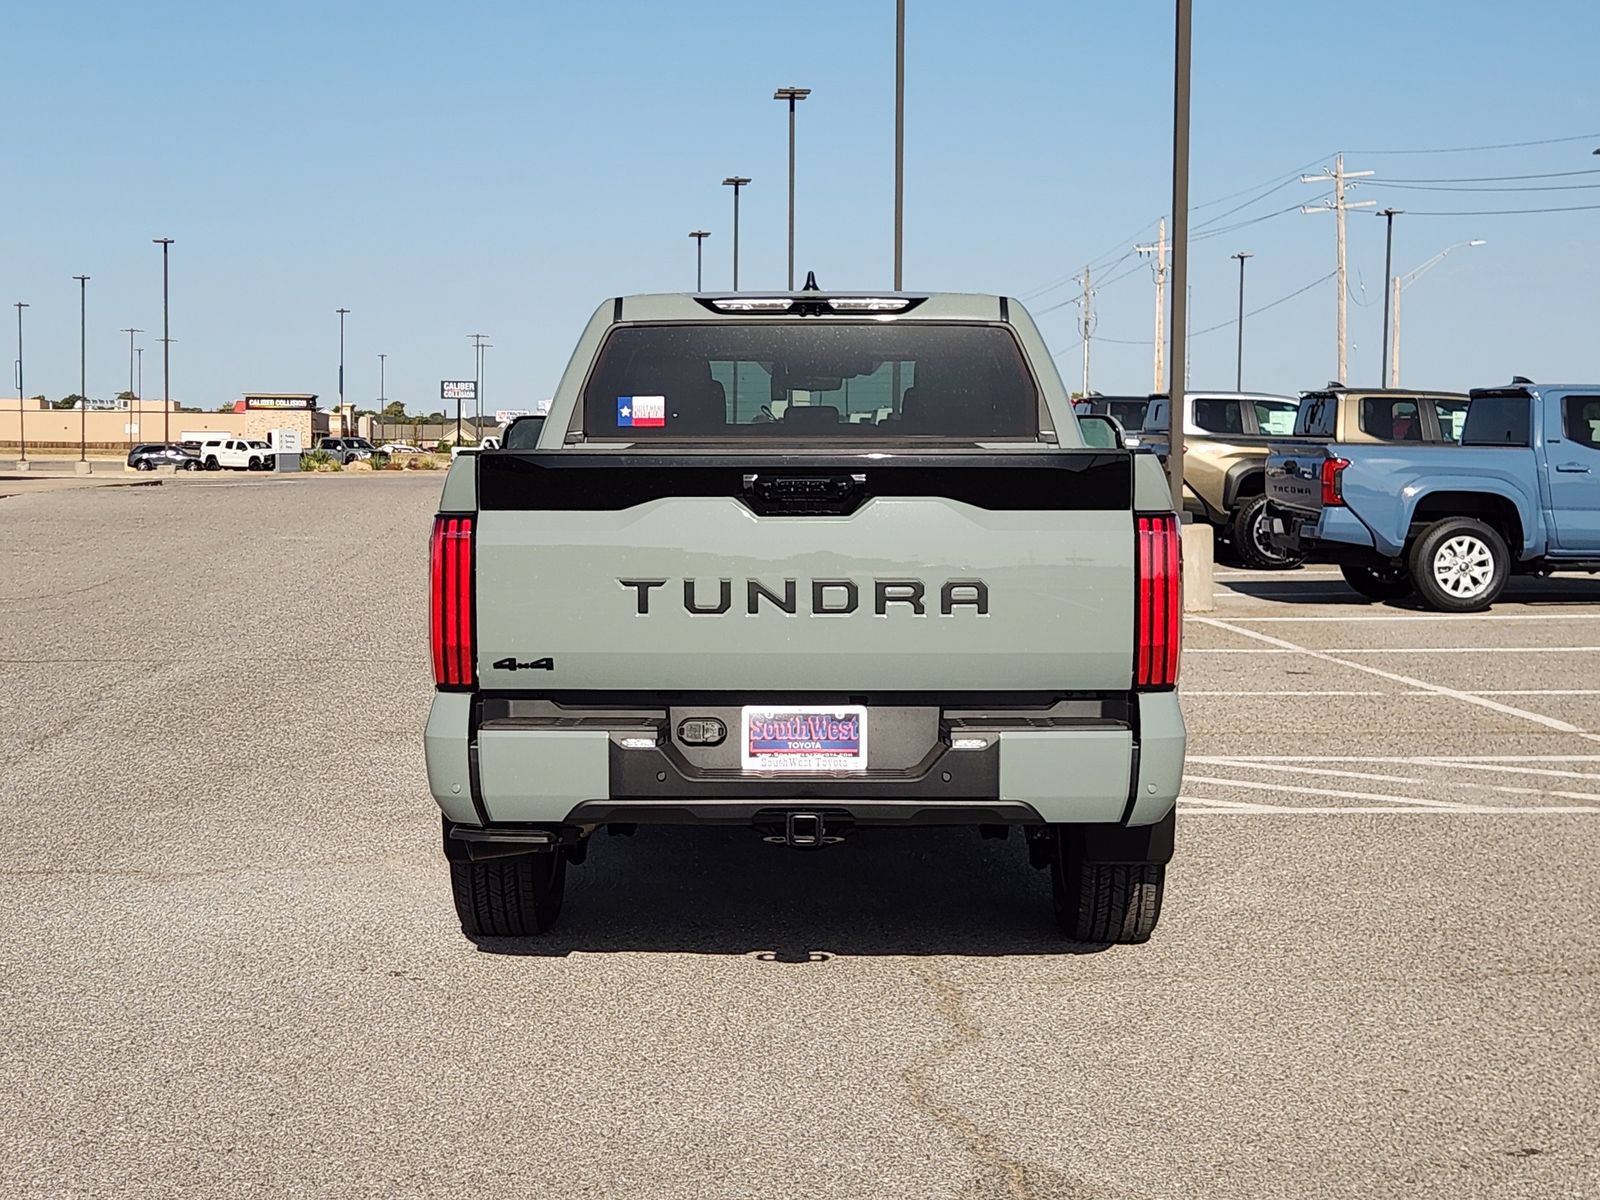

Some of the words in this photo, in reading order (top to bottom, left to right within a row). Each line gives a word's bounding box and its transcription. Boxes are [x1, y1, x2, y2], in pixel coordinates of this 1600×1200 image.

[443, 382, 475, 390] CALIBER
[275, 399, 307, 407] COLLISION
[1273, 485, 1312, 495] TACOMA
[616, 578, 990, 615] TUNDRA
[750, 715, 859, 740] SouthWest
[787, 741, 822, 749] TOYOTA
[816, 757, 848, 768] Toyota
